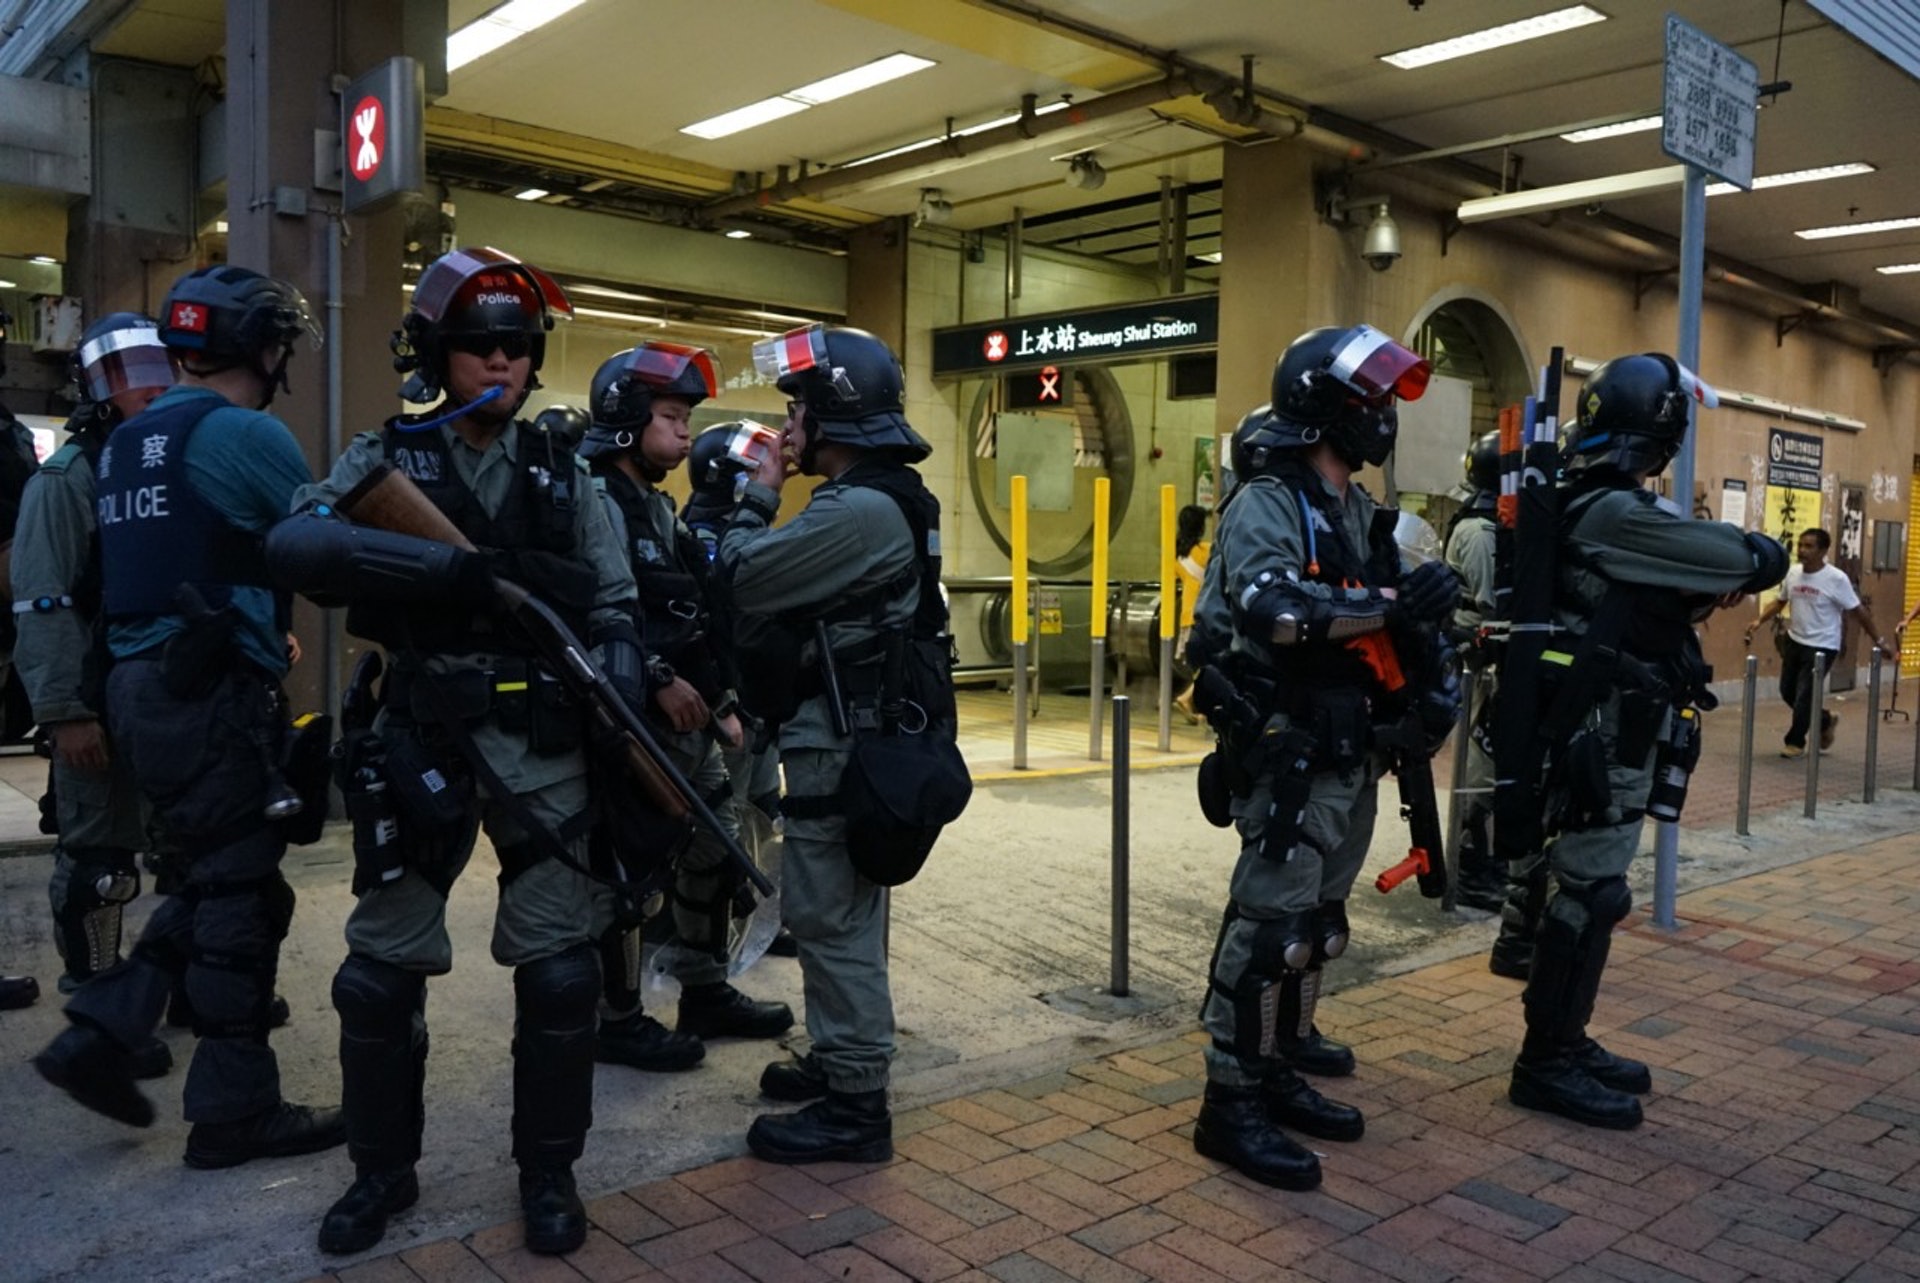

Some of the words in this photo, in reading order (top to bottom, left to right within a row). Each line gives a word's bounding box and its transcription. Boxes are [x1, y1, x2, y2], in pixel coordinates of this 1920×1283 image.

[476, 291, 521, 306] Police
[1015, 323, 1076, 356] 上水站
[1078, 330, 1122, 347] Sheung
[1123, 324, 1151, 342] Shui
[1152, 320, 1197, 339] Station
[98, 484, 170, 525] POLICE
